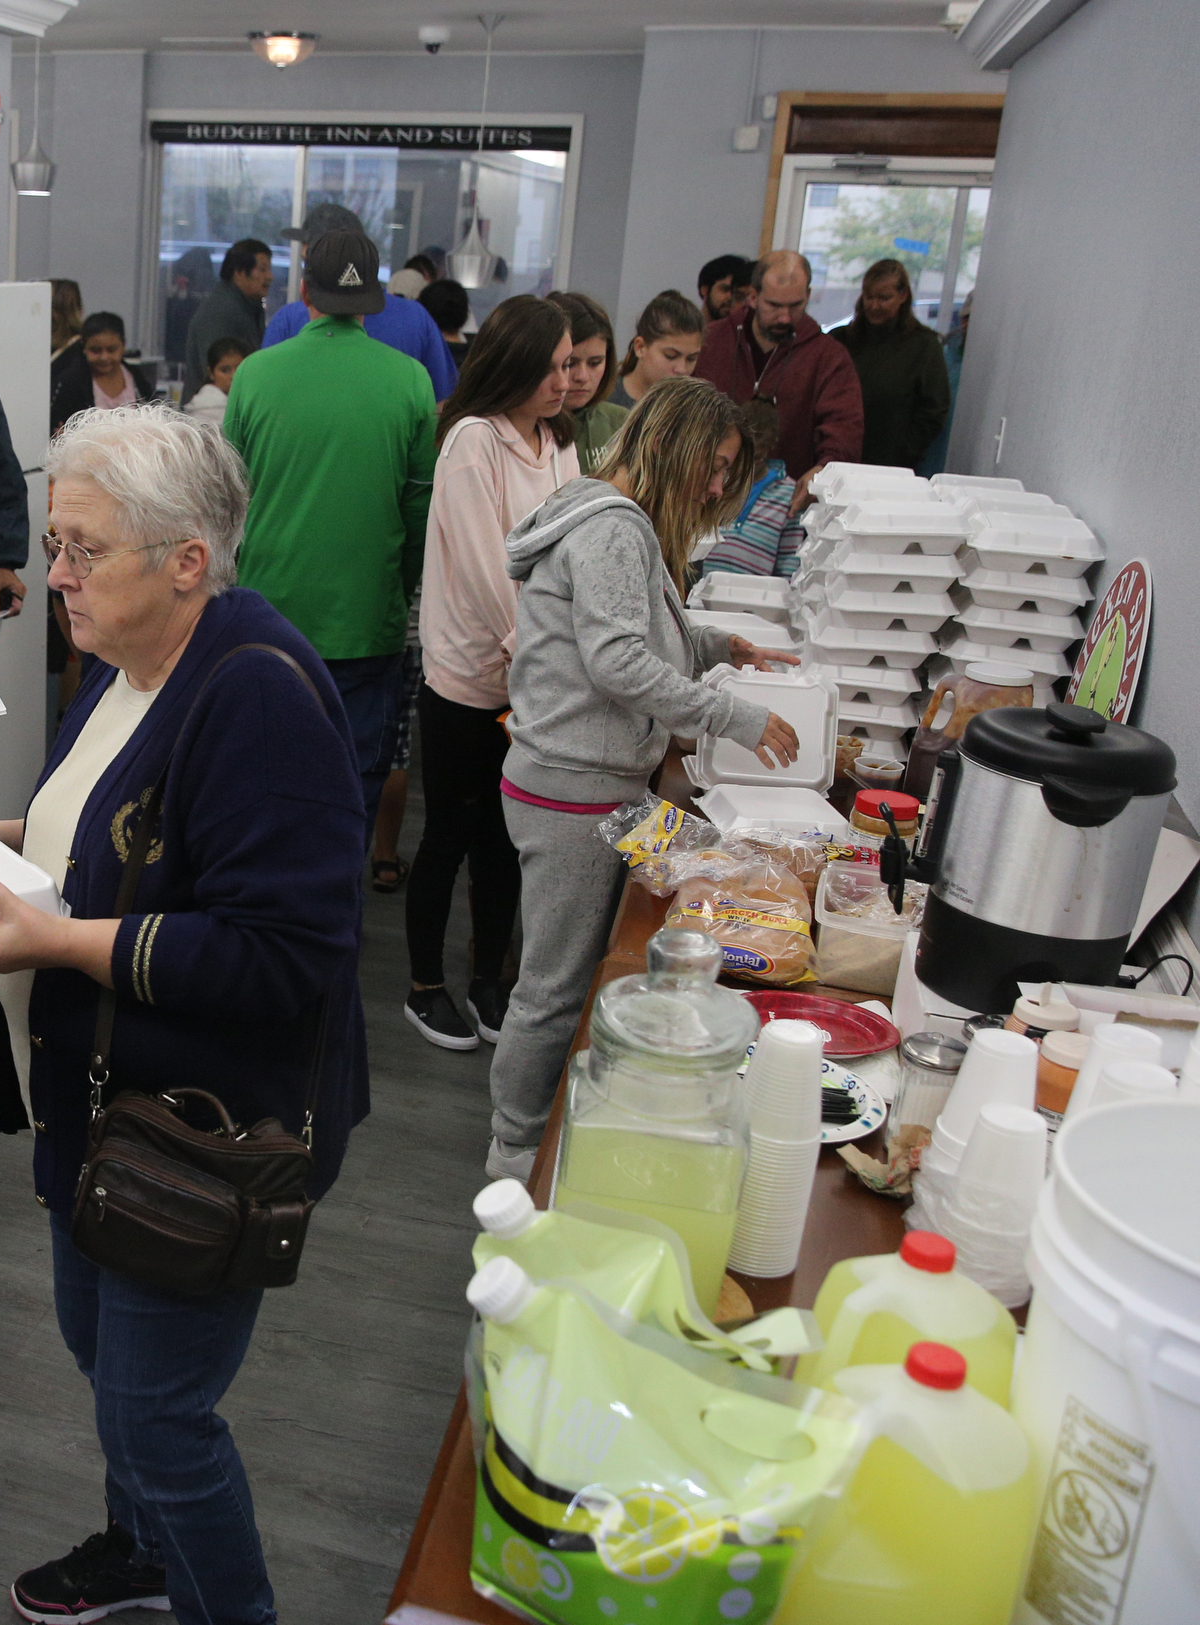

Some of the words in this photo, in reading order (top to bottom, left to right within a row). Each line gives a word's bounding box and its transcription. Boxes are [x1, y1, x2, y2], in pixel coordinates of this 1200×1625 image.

[186, 124, 318, 141] BUDGETEL
[326, 126, 371, 142] INN
[377, 127, 434, 144] AND
[440, 128, 533, 146] SUITES
[1068, 570, 1139, 700] HICKEN
[1111, 587, 1145, 720] SALA
[723, 951, 760, 967] lonial
